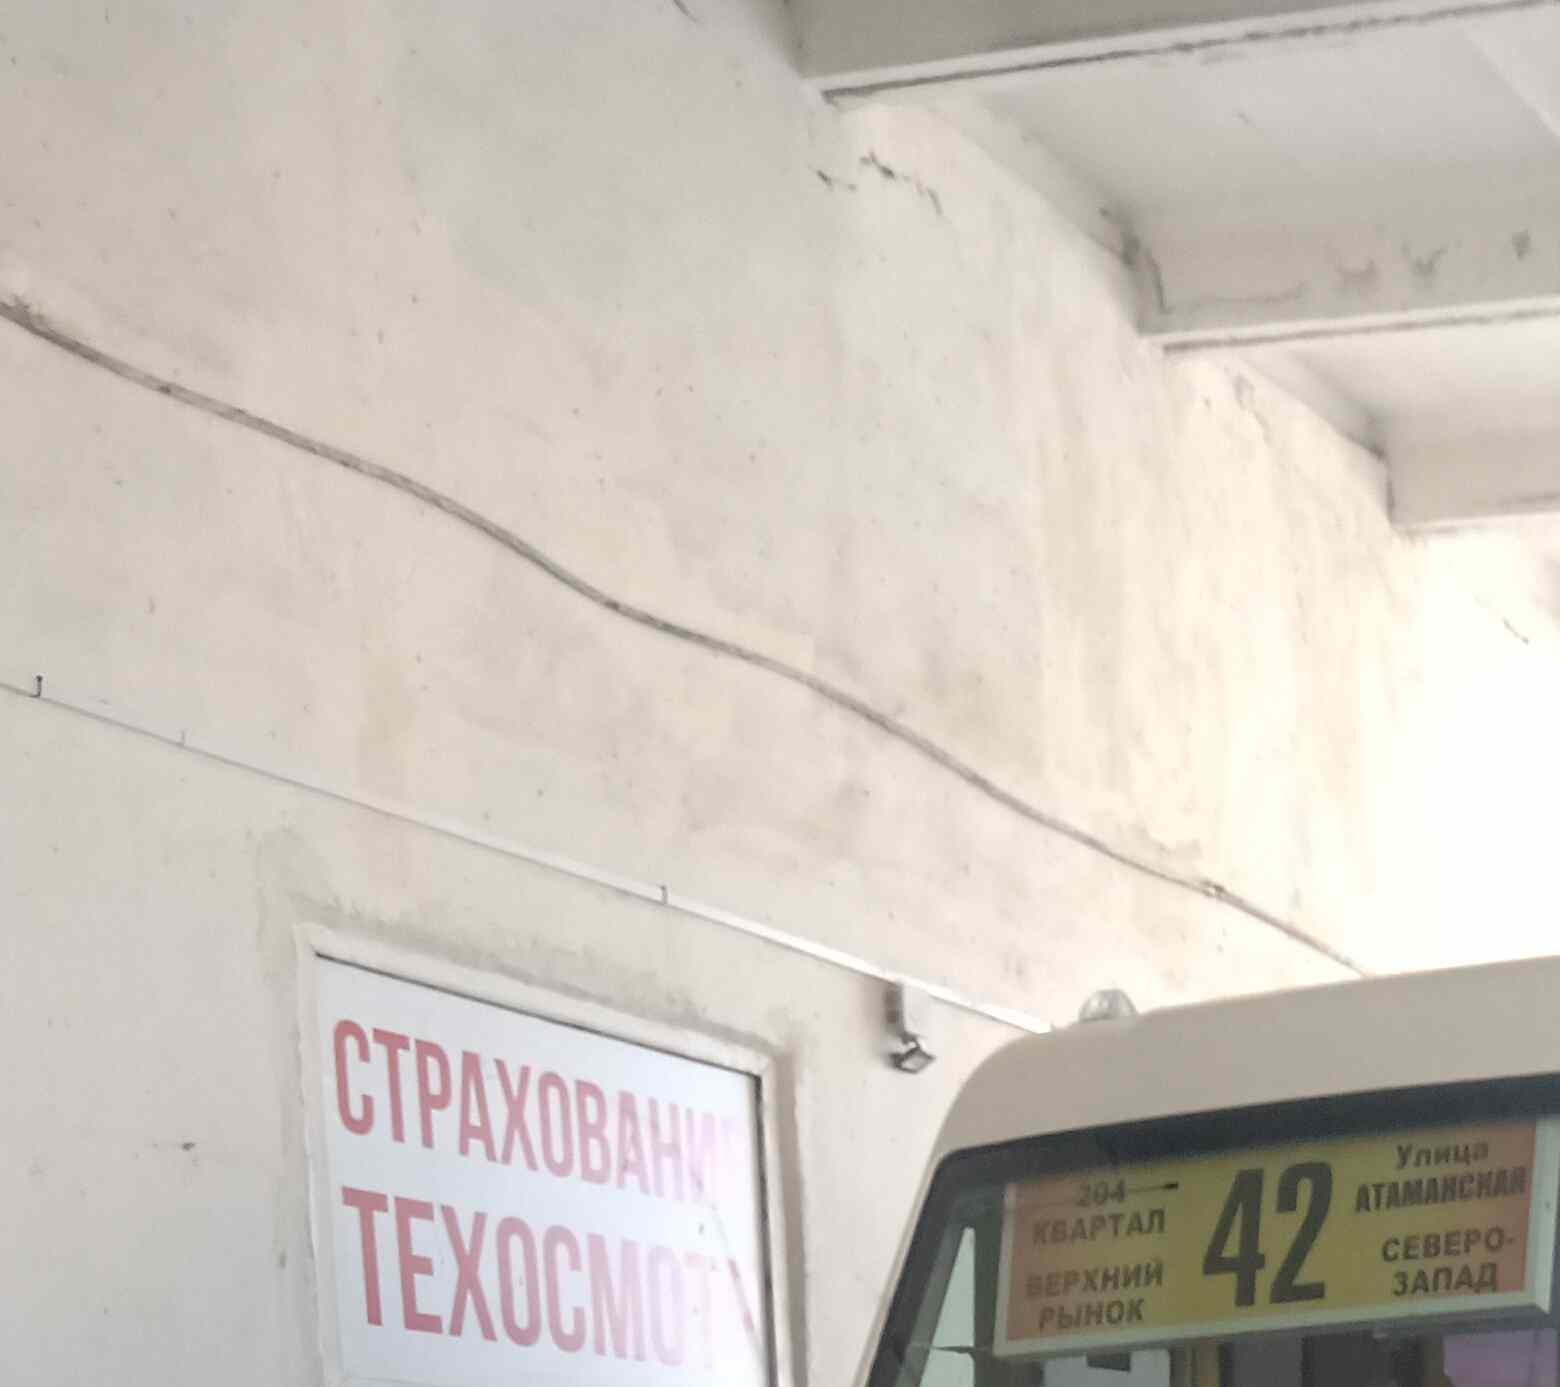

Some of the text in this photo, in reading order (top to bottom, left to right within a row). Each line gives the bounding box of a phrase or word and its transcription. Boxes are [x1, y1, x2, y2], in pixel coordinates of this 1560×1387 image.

[332, 1018, 738, 1206] СТРАХОВАНИ
[1397, 1141, 1489, 1169] Улица
[1354, 1166, 1527, 1213] АТАМАНСКАЯ
[1032, 1208, 1167, 1246] КВАРТАЛ
[1202, 1160, 1334, 1308] 42
[1381, 1226, 1515, 1263] СЕВЕРО-
[341, 1185, 718, 1370] ТЕХОСМОТ
[1025, 1257, 1165, 1300] ВЕРХНИЙ
[1392, 1262, 1498, 1297] ЗАПАД
[1038, 1298, 1145, 1331] РЫНОК
